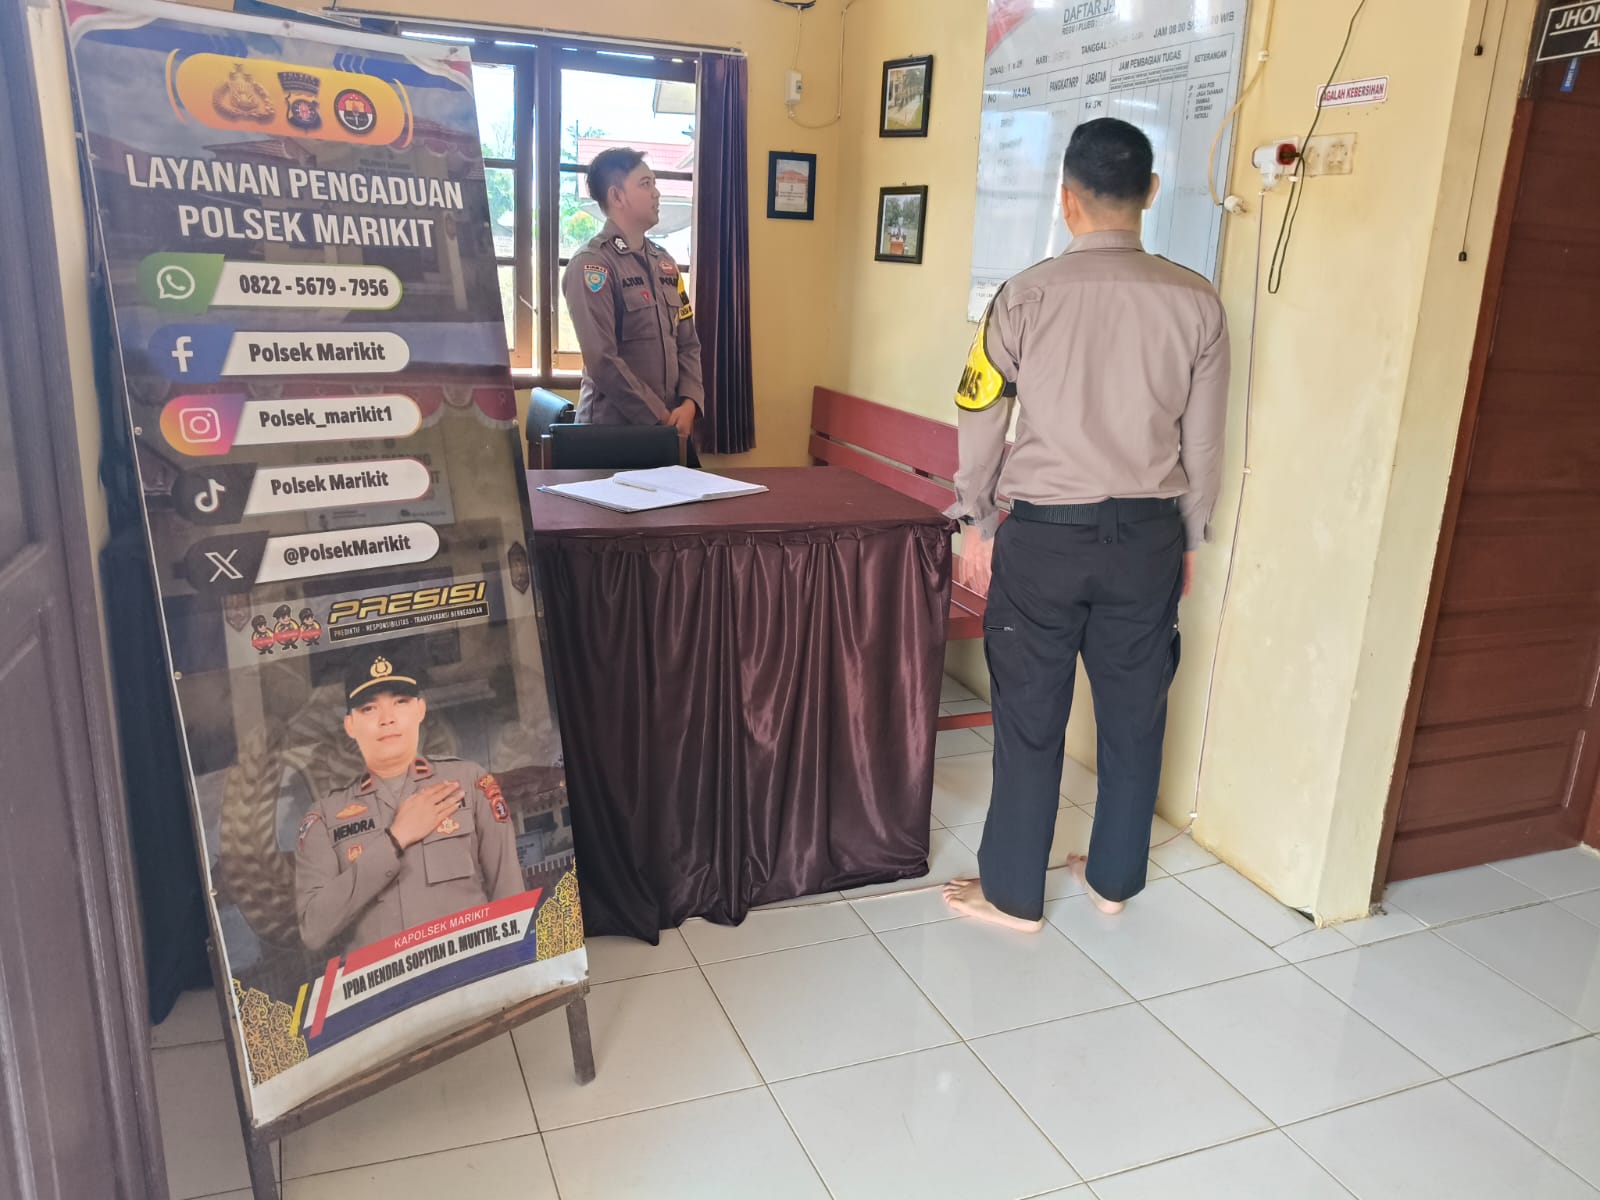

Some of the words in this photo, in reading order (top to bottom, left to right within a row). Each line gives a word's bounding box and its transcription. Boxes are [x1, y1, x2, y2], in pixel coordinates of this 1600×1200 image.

[1064, 0, 1101, 23] DAFTAR
[1081, 42, 1107, 54] TANGGAL
[1013, 86, 1031, 98] NAMA
[1321, 88, 1346, 102] AGALAH
[1346, 83, 1385, 99] KEBERSIHAN
[126, 154, 280, 196] LAYANAN
[290, 167, 463, 210] PENGADUAN
[178, 205, 306, 243] POLSEK
[313, 211, 435, 248] MARIKIT
[239, 274, 281, 295] 0822
[296, 275, 337, 296] 5679
[349, 277, 389, 297] 7956
[248, 342, 313, 362] Polsek
[316, 342, 386, 362] Marikit
[259, 406, 393, 428] Polsek_marikit1
[270, 475, 326, 496] Polsek
[329, 471, 389, 491] Marikit
[284, 535, 411, 566] @PolsekMarikit
[328, 580, 487, 625] PRESISI
[333, 818, 375, 842] HENDRA
[394, 922, 448, 949] KAPOLSEK
[449, 907, 491, 929] MARIKIT
[343, 977, 368, 1000] IPDA
[367, 961, 405, 989] HENDRA
[406, 945, 446, 972] SOPIYAN
